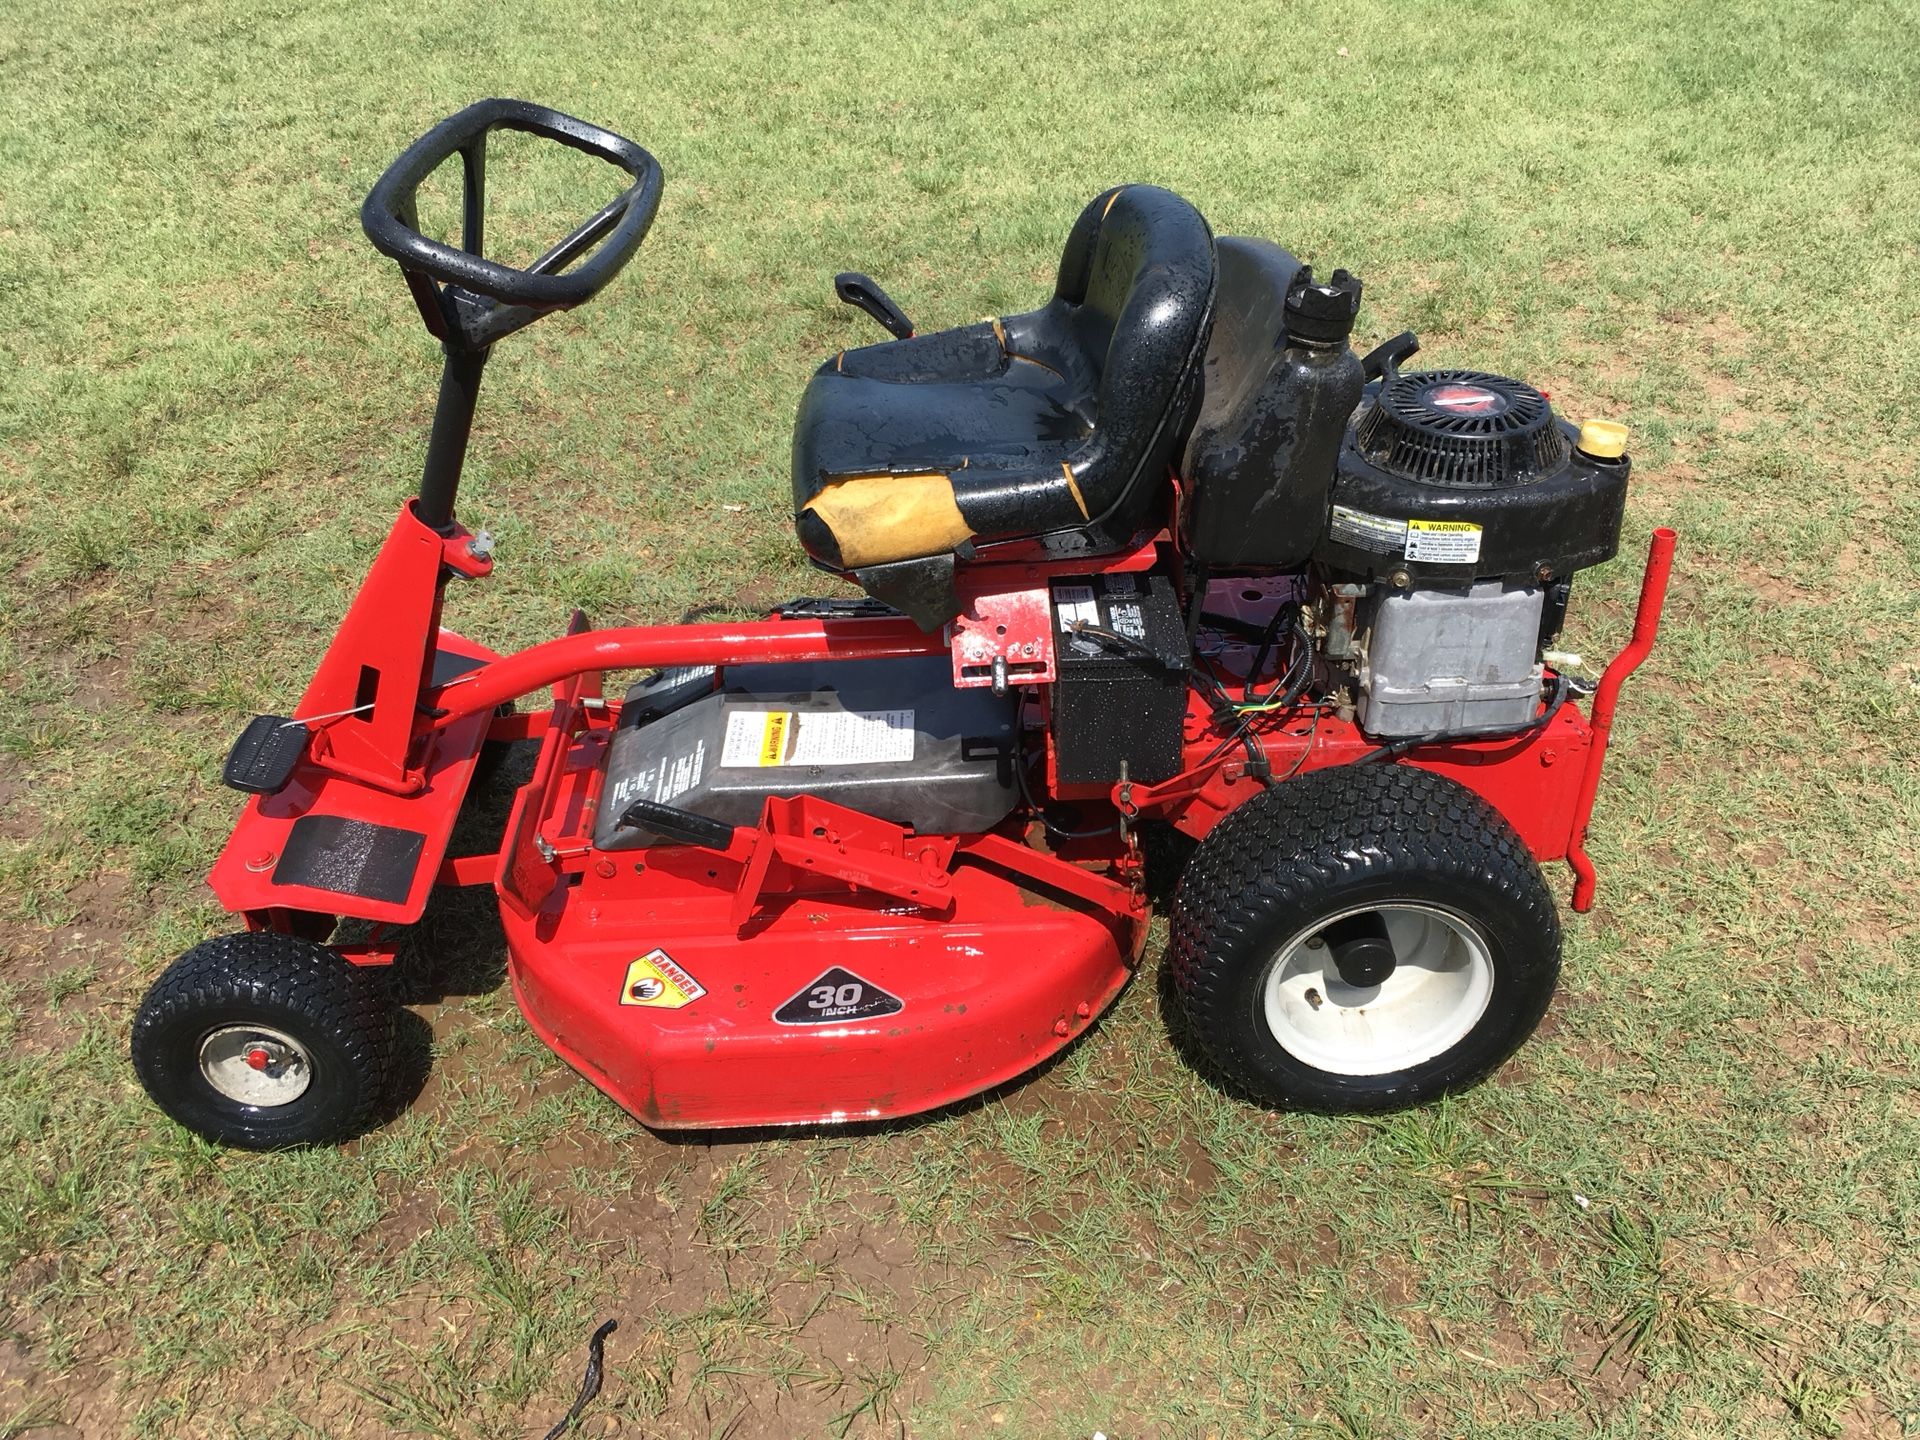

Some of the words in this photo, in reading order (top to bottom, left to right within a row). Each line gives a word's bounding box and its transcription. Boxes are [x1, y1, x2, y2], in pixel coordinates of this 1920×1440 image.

[1428, 523, 1471, 532] WARNING
[768, 727, 781, 753] WARNING
[651, 954, 699, 996] DANGER
[808, 983, 863, 1009] 30
[821, 1005, 857, 1016] INCH
